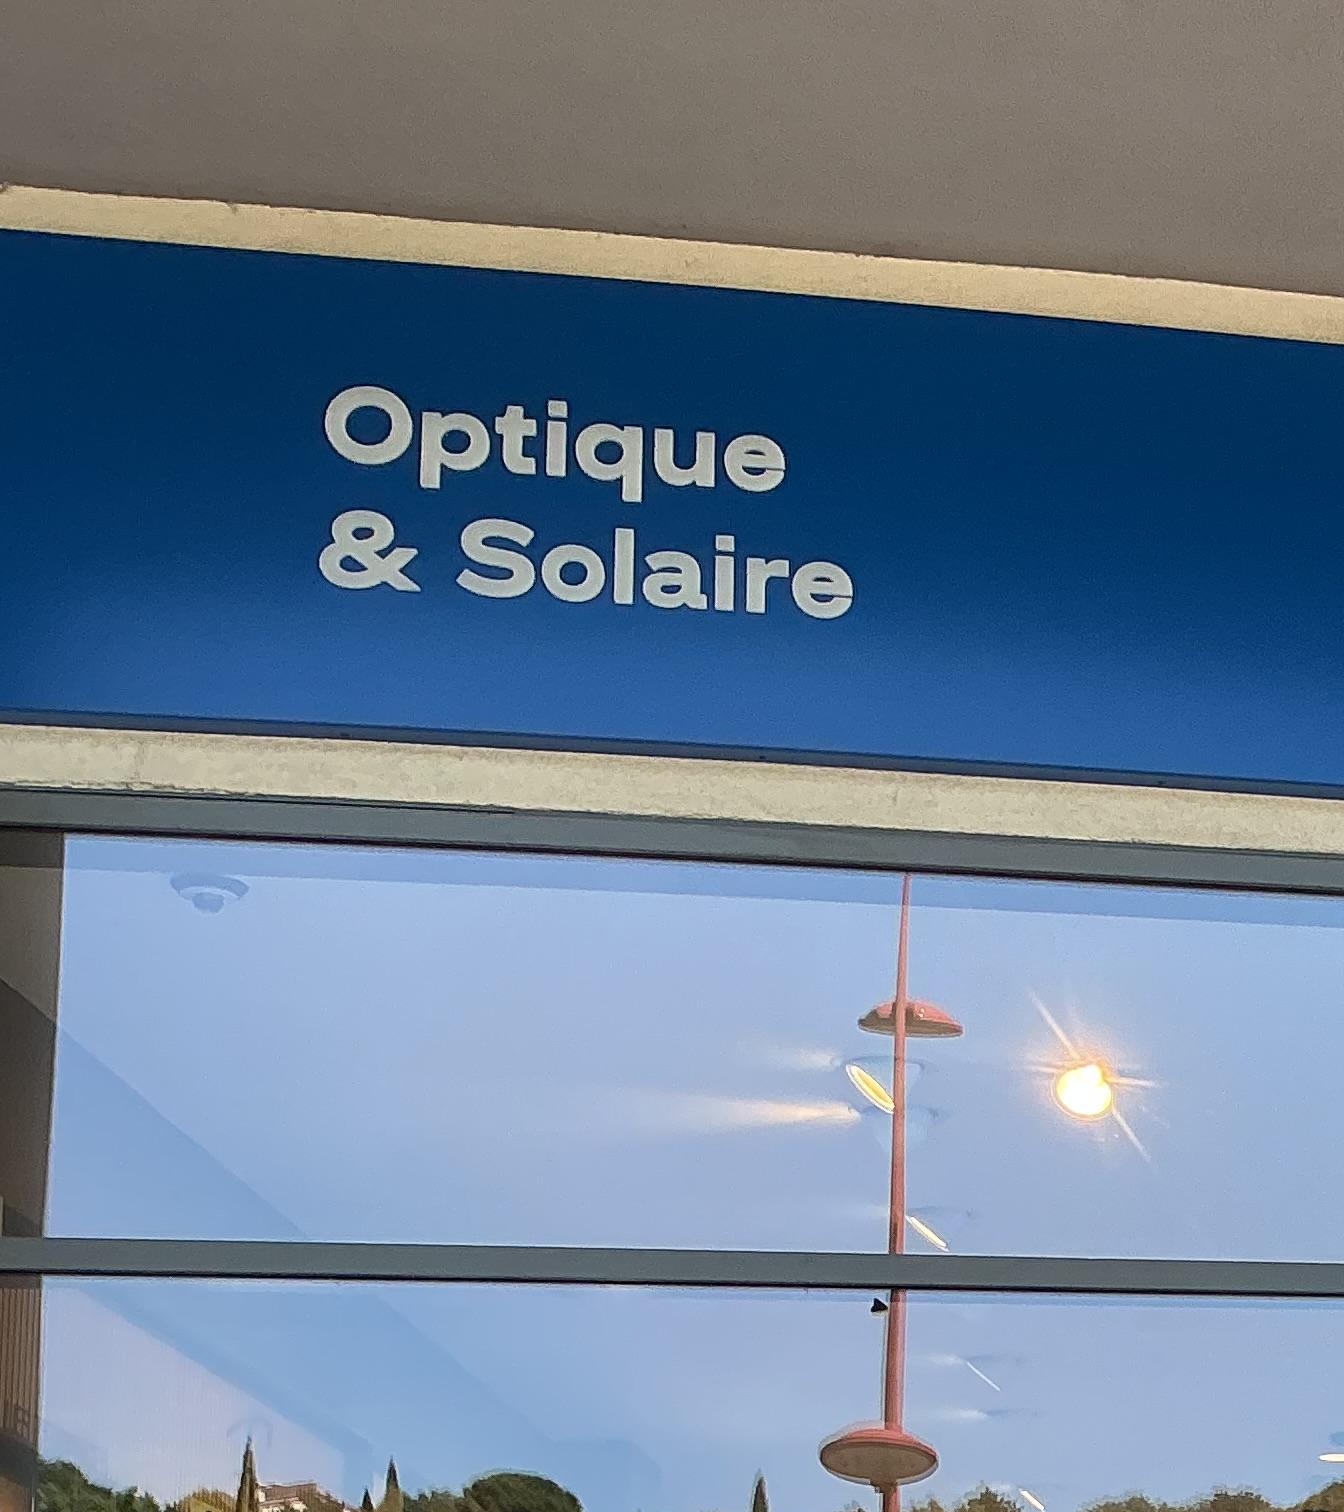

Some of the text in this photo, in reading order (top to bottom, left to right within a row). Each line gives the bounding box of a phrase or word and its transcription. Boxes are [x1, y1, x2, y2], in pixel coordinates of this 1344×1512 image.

[324, 385, 787, 503] Optique
[318, 509, 854, 620] & Solaire
